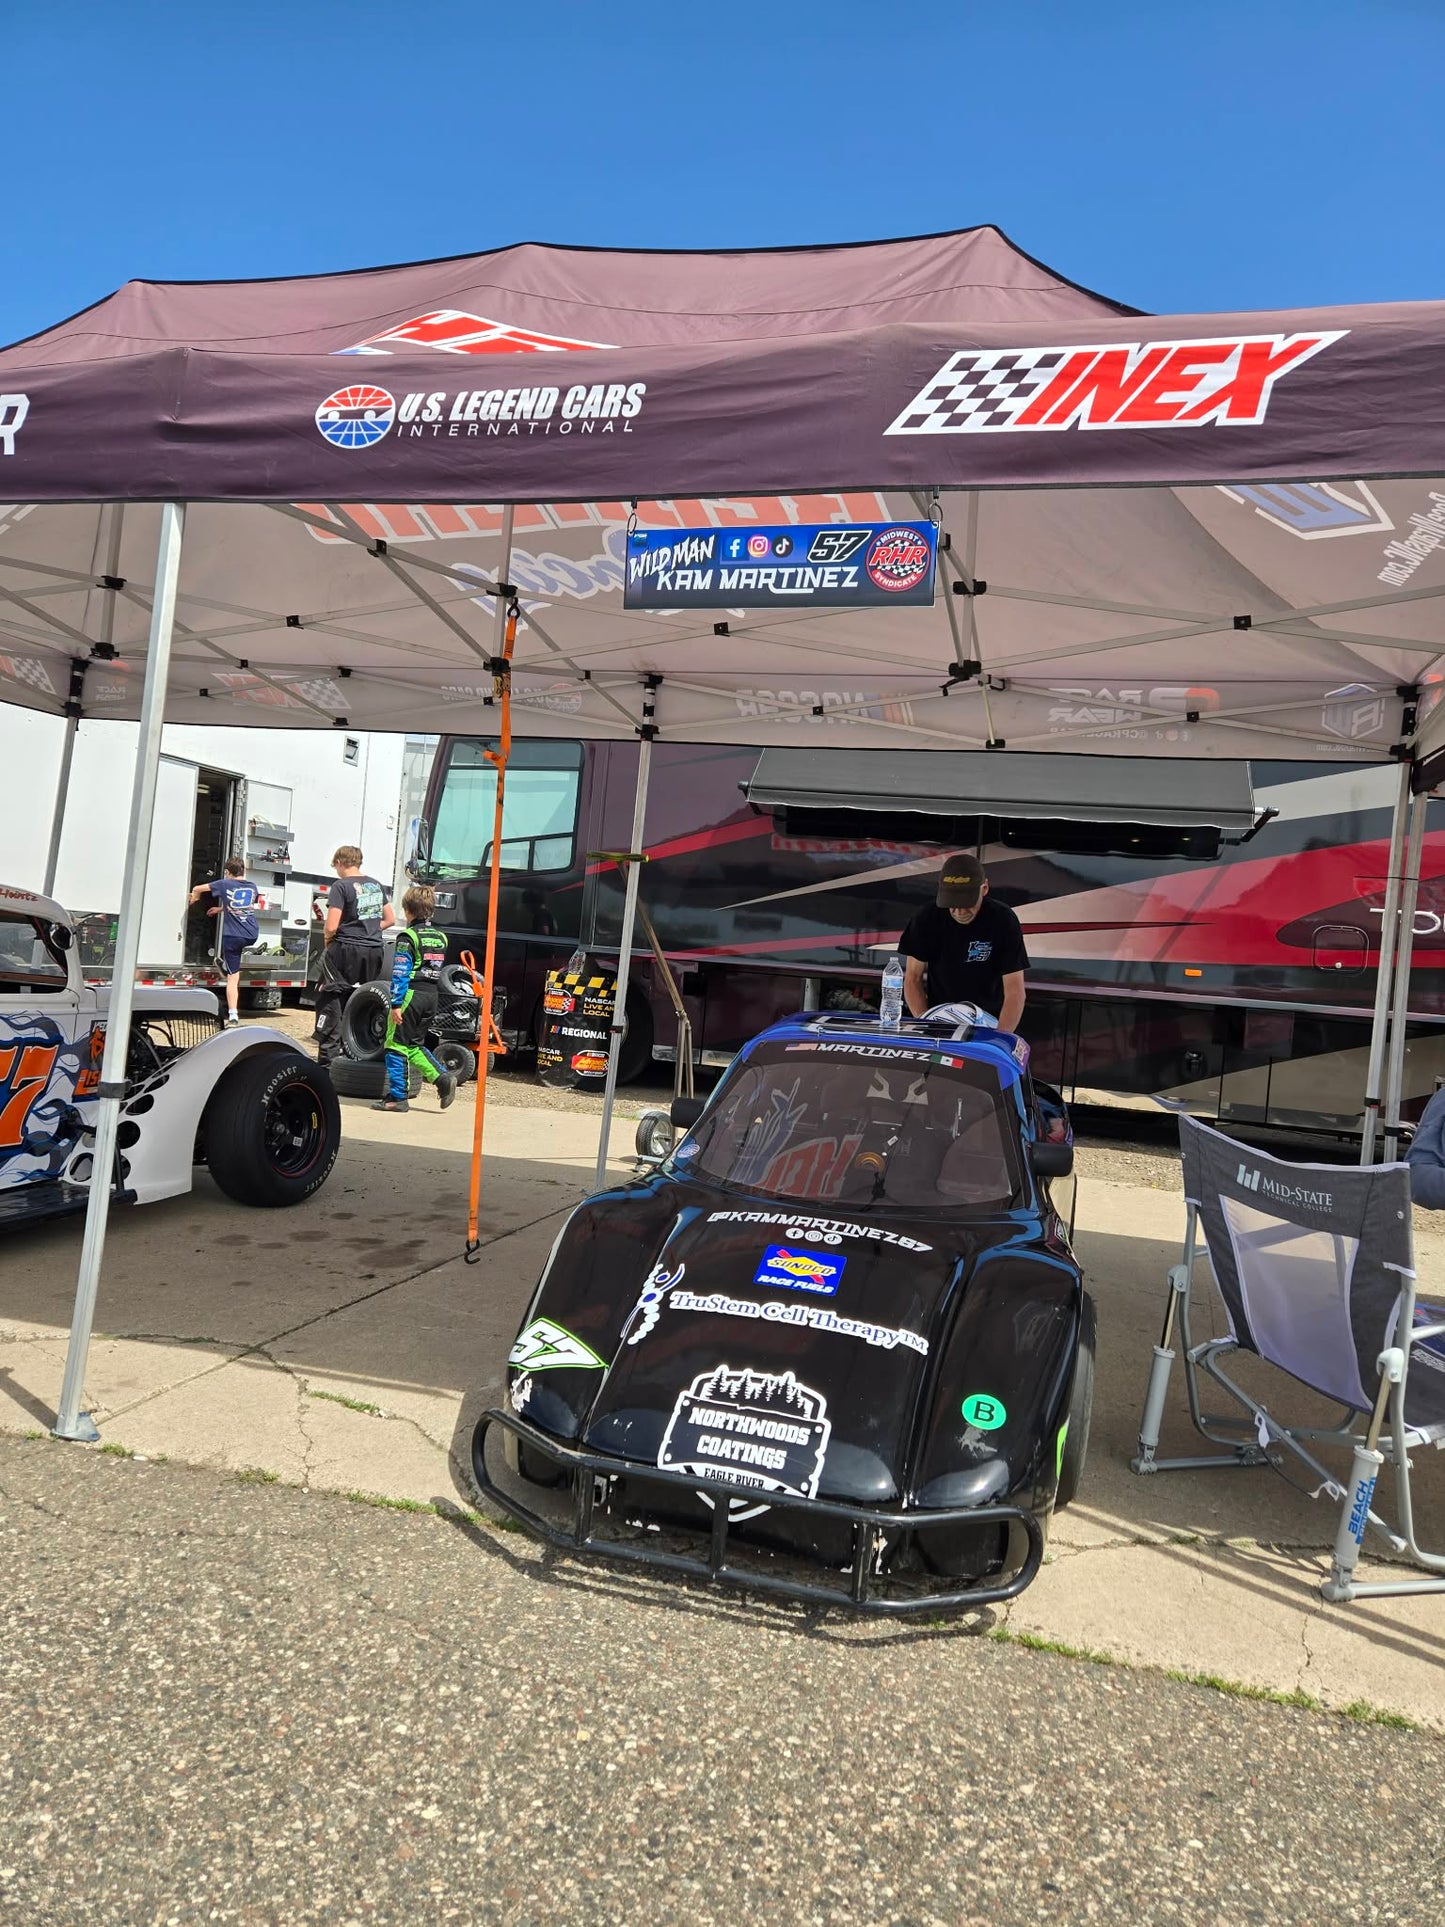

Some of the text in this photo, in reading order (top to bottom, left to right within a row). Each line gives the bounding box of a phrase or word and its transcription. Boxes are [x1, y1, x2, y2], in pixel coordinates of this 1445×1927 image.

[1012, 338, 1324, 425] INEX
[398, 383, 647, 423] U.S. LEGEND CARS
[397, 420, 634, 438] INTERNATIONAL
[806, 530, 872, 564] 57
[880, 531, 919, 543] MIDWEST
[869, 545, 927, 566] RHR
[656, 566, 858, 594] KAM MARTINEZ
[874, 572, 917, 587] SYNDICATE
[230, 888, 253, 908] 9
[561, 1027, 607, 1040] REGIONAL
[817, 1043, 932, 1062] MARTINEZ
[261, 1065, 297, 1106] Hoosier
[1262, 1177, 1333, 1206] MID-STATE
[1262, 1190, 1333, 1213] TECHNICAL COLLEGE
[771, 1258, 833, 1275] SUNOCO
[757, 1275, 835, 1294] RACE FUELS
[672, 1292, 758, 1316] TruStem
[763, 1303, 806, 1323] Cell
[508, 1319, 600, 1368] 57
[974, 1401, 995, 1422] B
[688, 1407, 811, 1446] NORTHWOODS
[696, 1435, 787, 1470] COATINGS
[704, 1468, 765, 1489] EAGLE RIVER
[1348, 1480, 1369, 1534] BEACH
